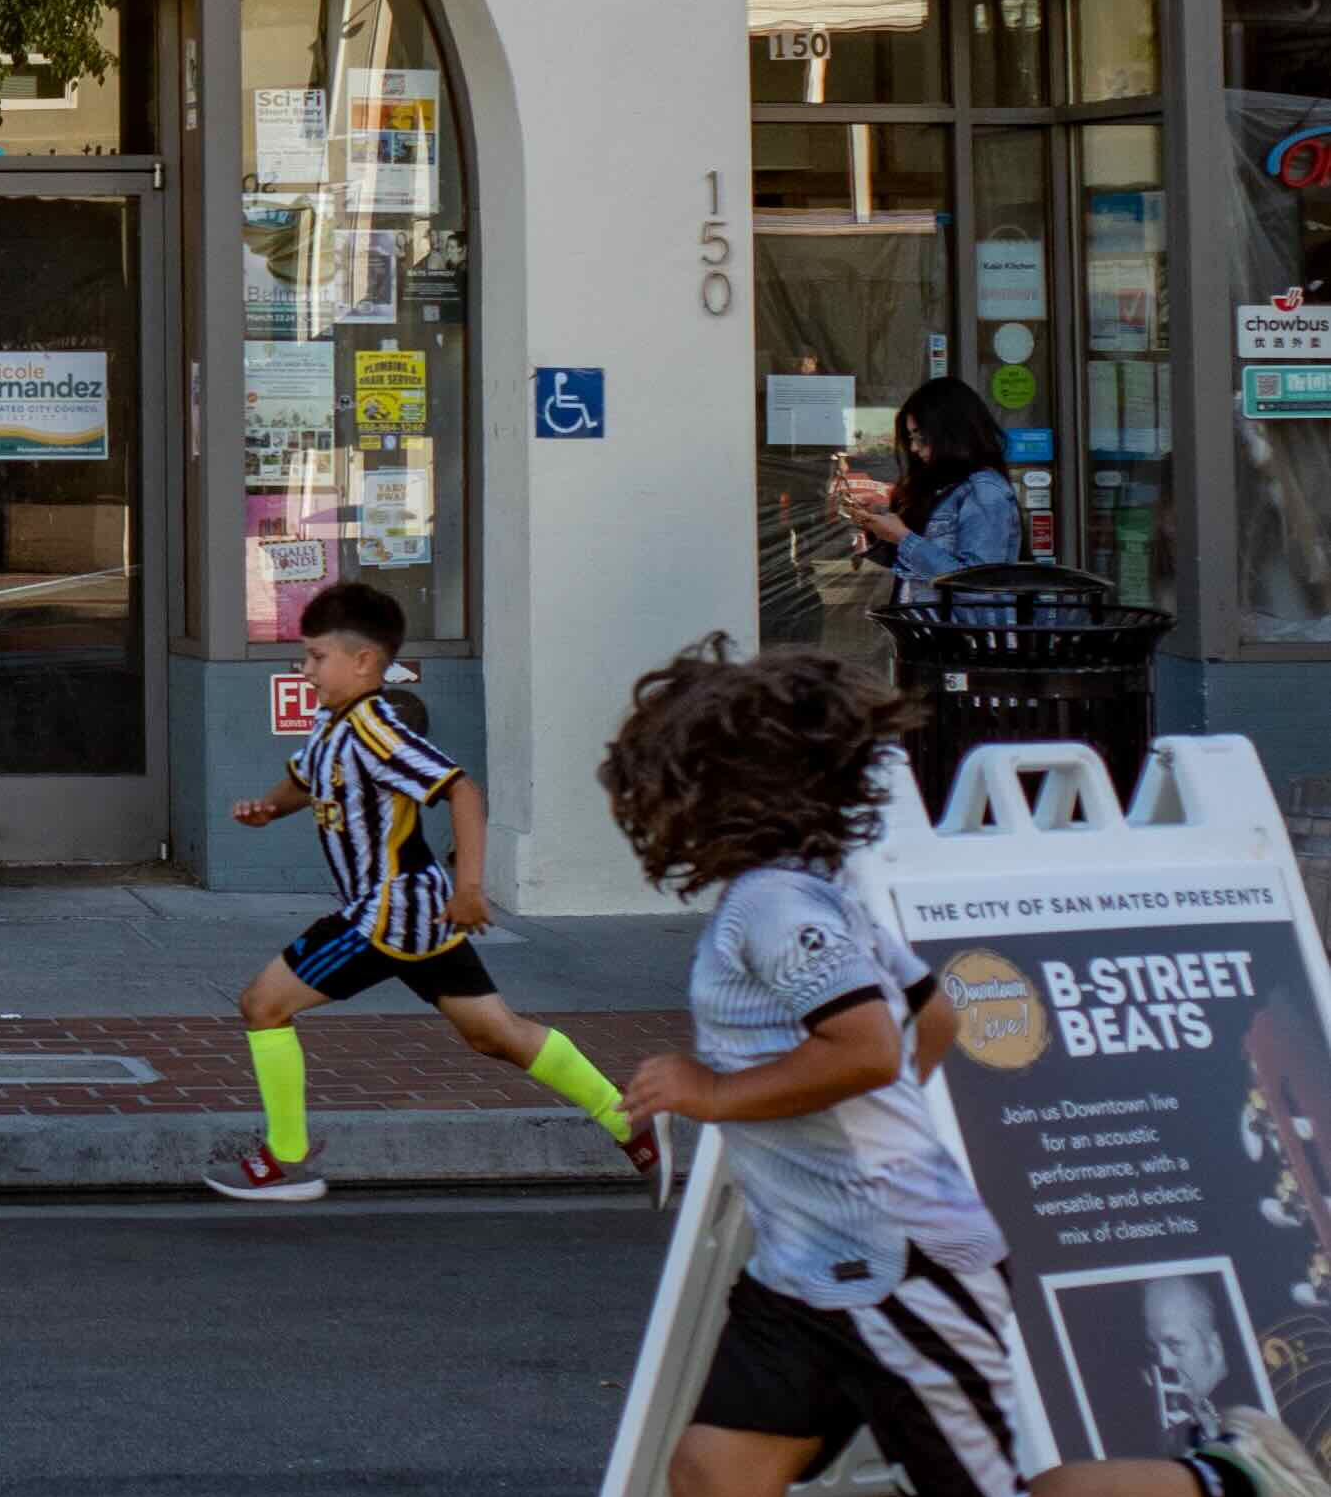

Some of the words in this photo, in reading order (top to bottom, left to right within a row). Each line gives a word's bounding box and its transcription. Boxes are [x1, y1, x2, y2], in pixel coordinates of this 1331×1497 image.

[774, 33, 828, 58] 150
[257, 90, 322, 108] Sci-Fi
[701, 170, 731, 316] 150
[1245, 315, 1330, 333] chowbus
[917, 904, 959, 923] THE
[964, 900, 1010, 920] CITY
[1017, 898, 1044, 917] OF
[1050, 896, 1092, 915] SAN
[1099, 891, 1170, 912] MATEO
[1175, 886, 1274, 907] PRESENTS
[1041, 950, 1255, 1009] B-STREET
[1055, 1001, 1213, 1058] BEATS
[1001, 1104, 1038, 1125] Join
[1040, 1106, 1061, 1121] us
[1059, 1098, 1150, 1120] Downtown
[1149, 1092, 1179, 1111] live
[1041, 1132, 1066, 1152] for
[1070, 1134, 1092, 1150] an
[1095, 1126, 1160, 1148] acoustic
[1028, 1162, 1139, 1189] performance,
[1142, 1155, 1176, 1174] with
[1178, 1157, 1190, 1171] a
[1033, 1194, 1106, 1217] versatile
[1108, 1189, 1139, 1209] and
[1142, 1184, 1204, 1205] eclectic
[1058, 1226, 1092, 1245] mix
[1094, 1221, 1112, 1242] of
[1113, 1219, 1165, 1241] classic
[1163, 1214, 1200, 1234] hits
